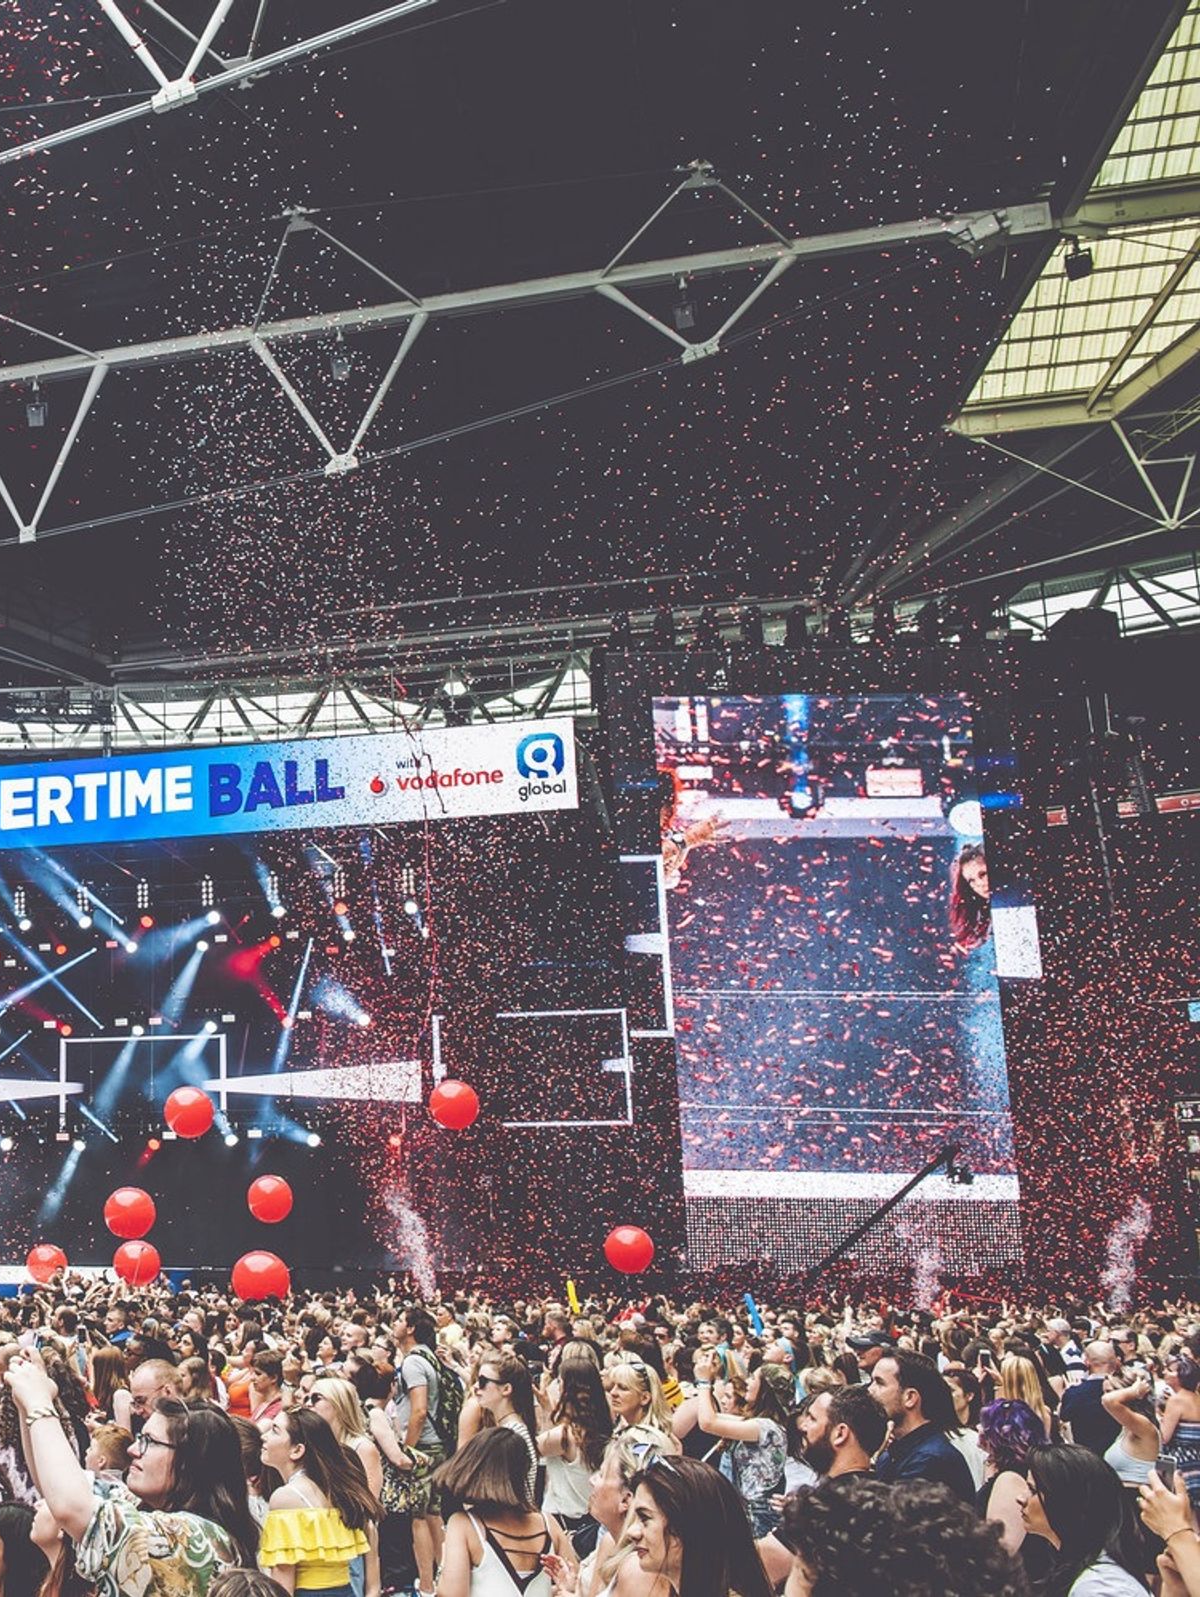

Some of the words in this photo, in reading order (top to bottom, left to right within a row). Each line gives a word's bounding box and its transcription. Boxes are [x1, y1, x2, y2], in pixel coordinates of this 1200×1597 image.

[208, 759, 345, 817] BALL
[396, 768, 504, 790] vodafone
[518, 780, 566, 801] global
